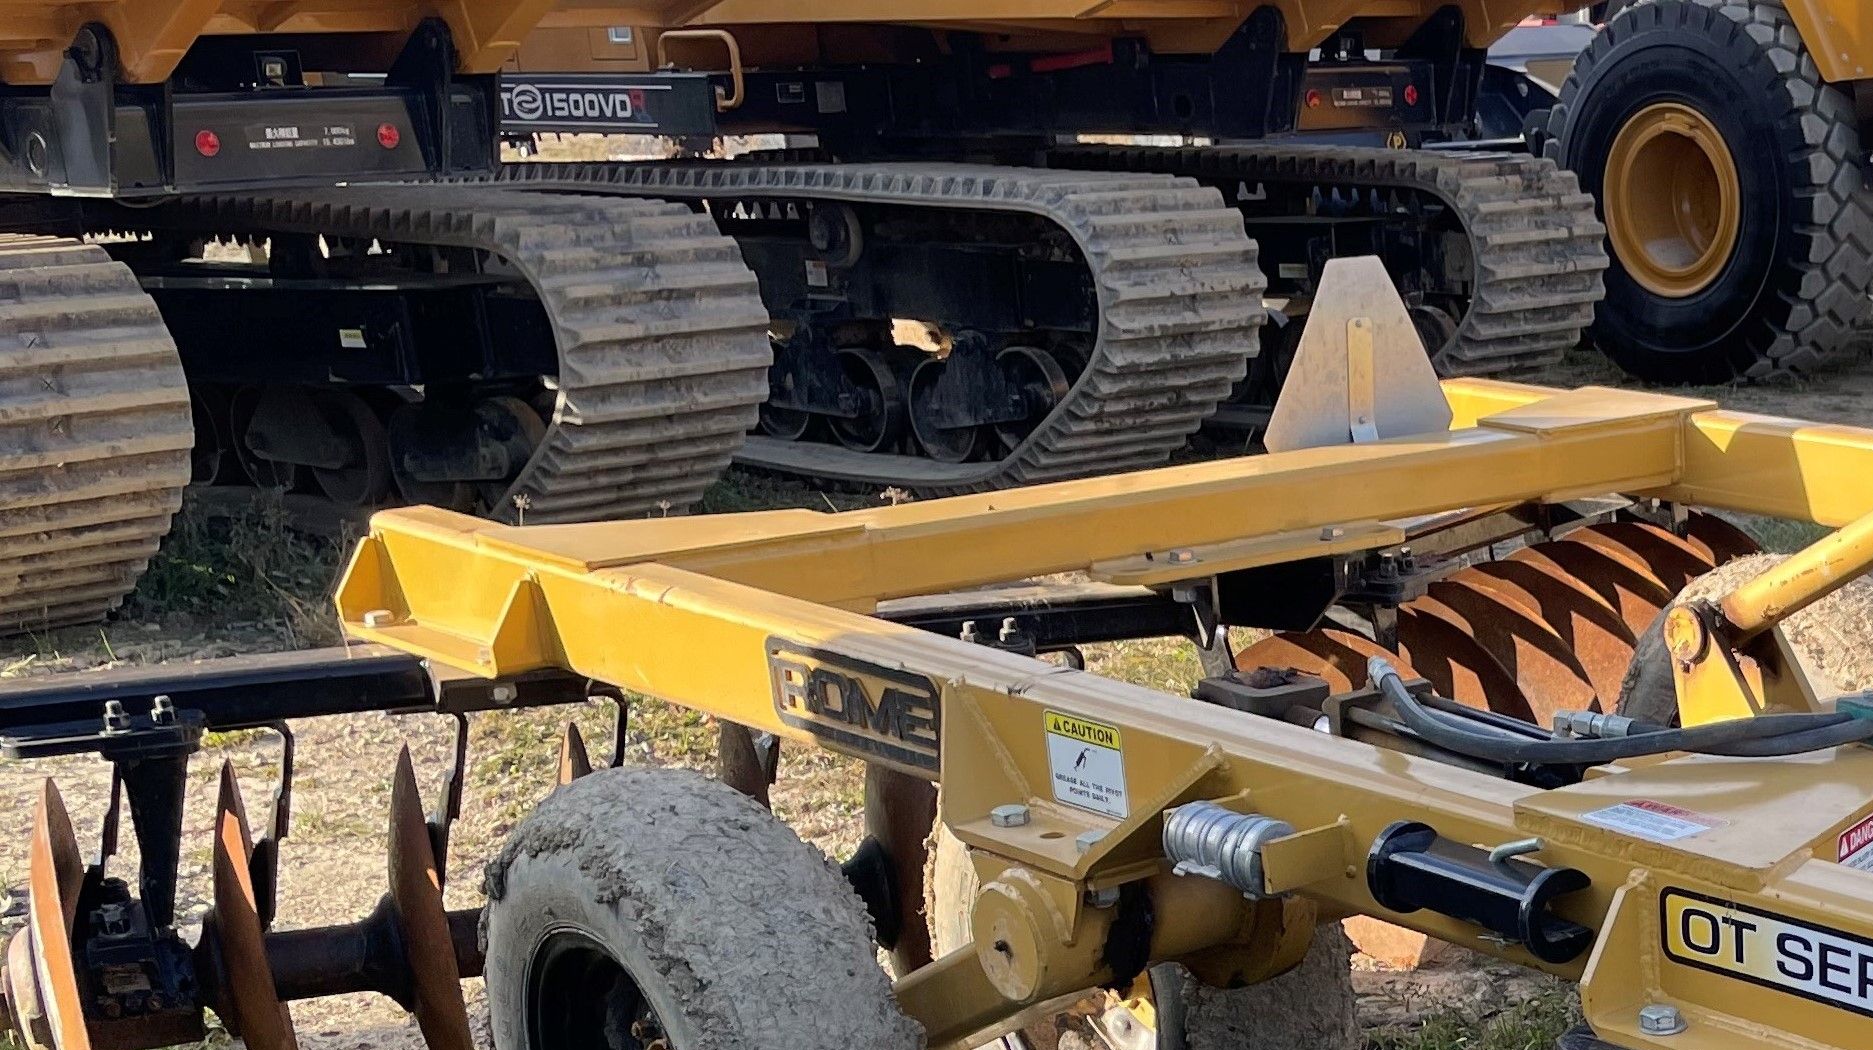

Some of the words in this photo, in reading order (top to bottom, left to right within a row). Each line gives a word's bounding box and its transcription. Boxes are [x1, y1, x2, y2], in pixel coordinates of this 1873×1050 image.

[773, 657, 938, 745] ROME
[1063, 720, 1114, 745] CAUTION
[1681, 908, 1757, 964] OT
